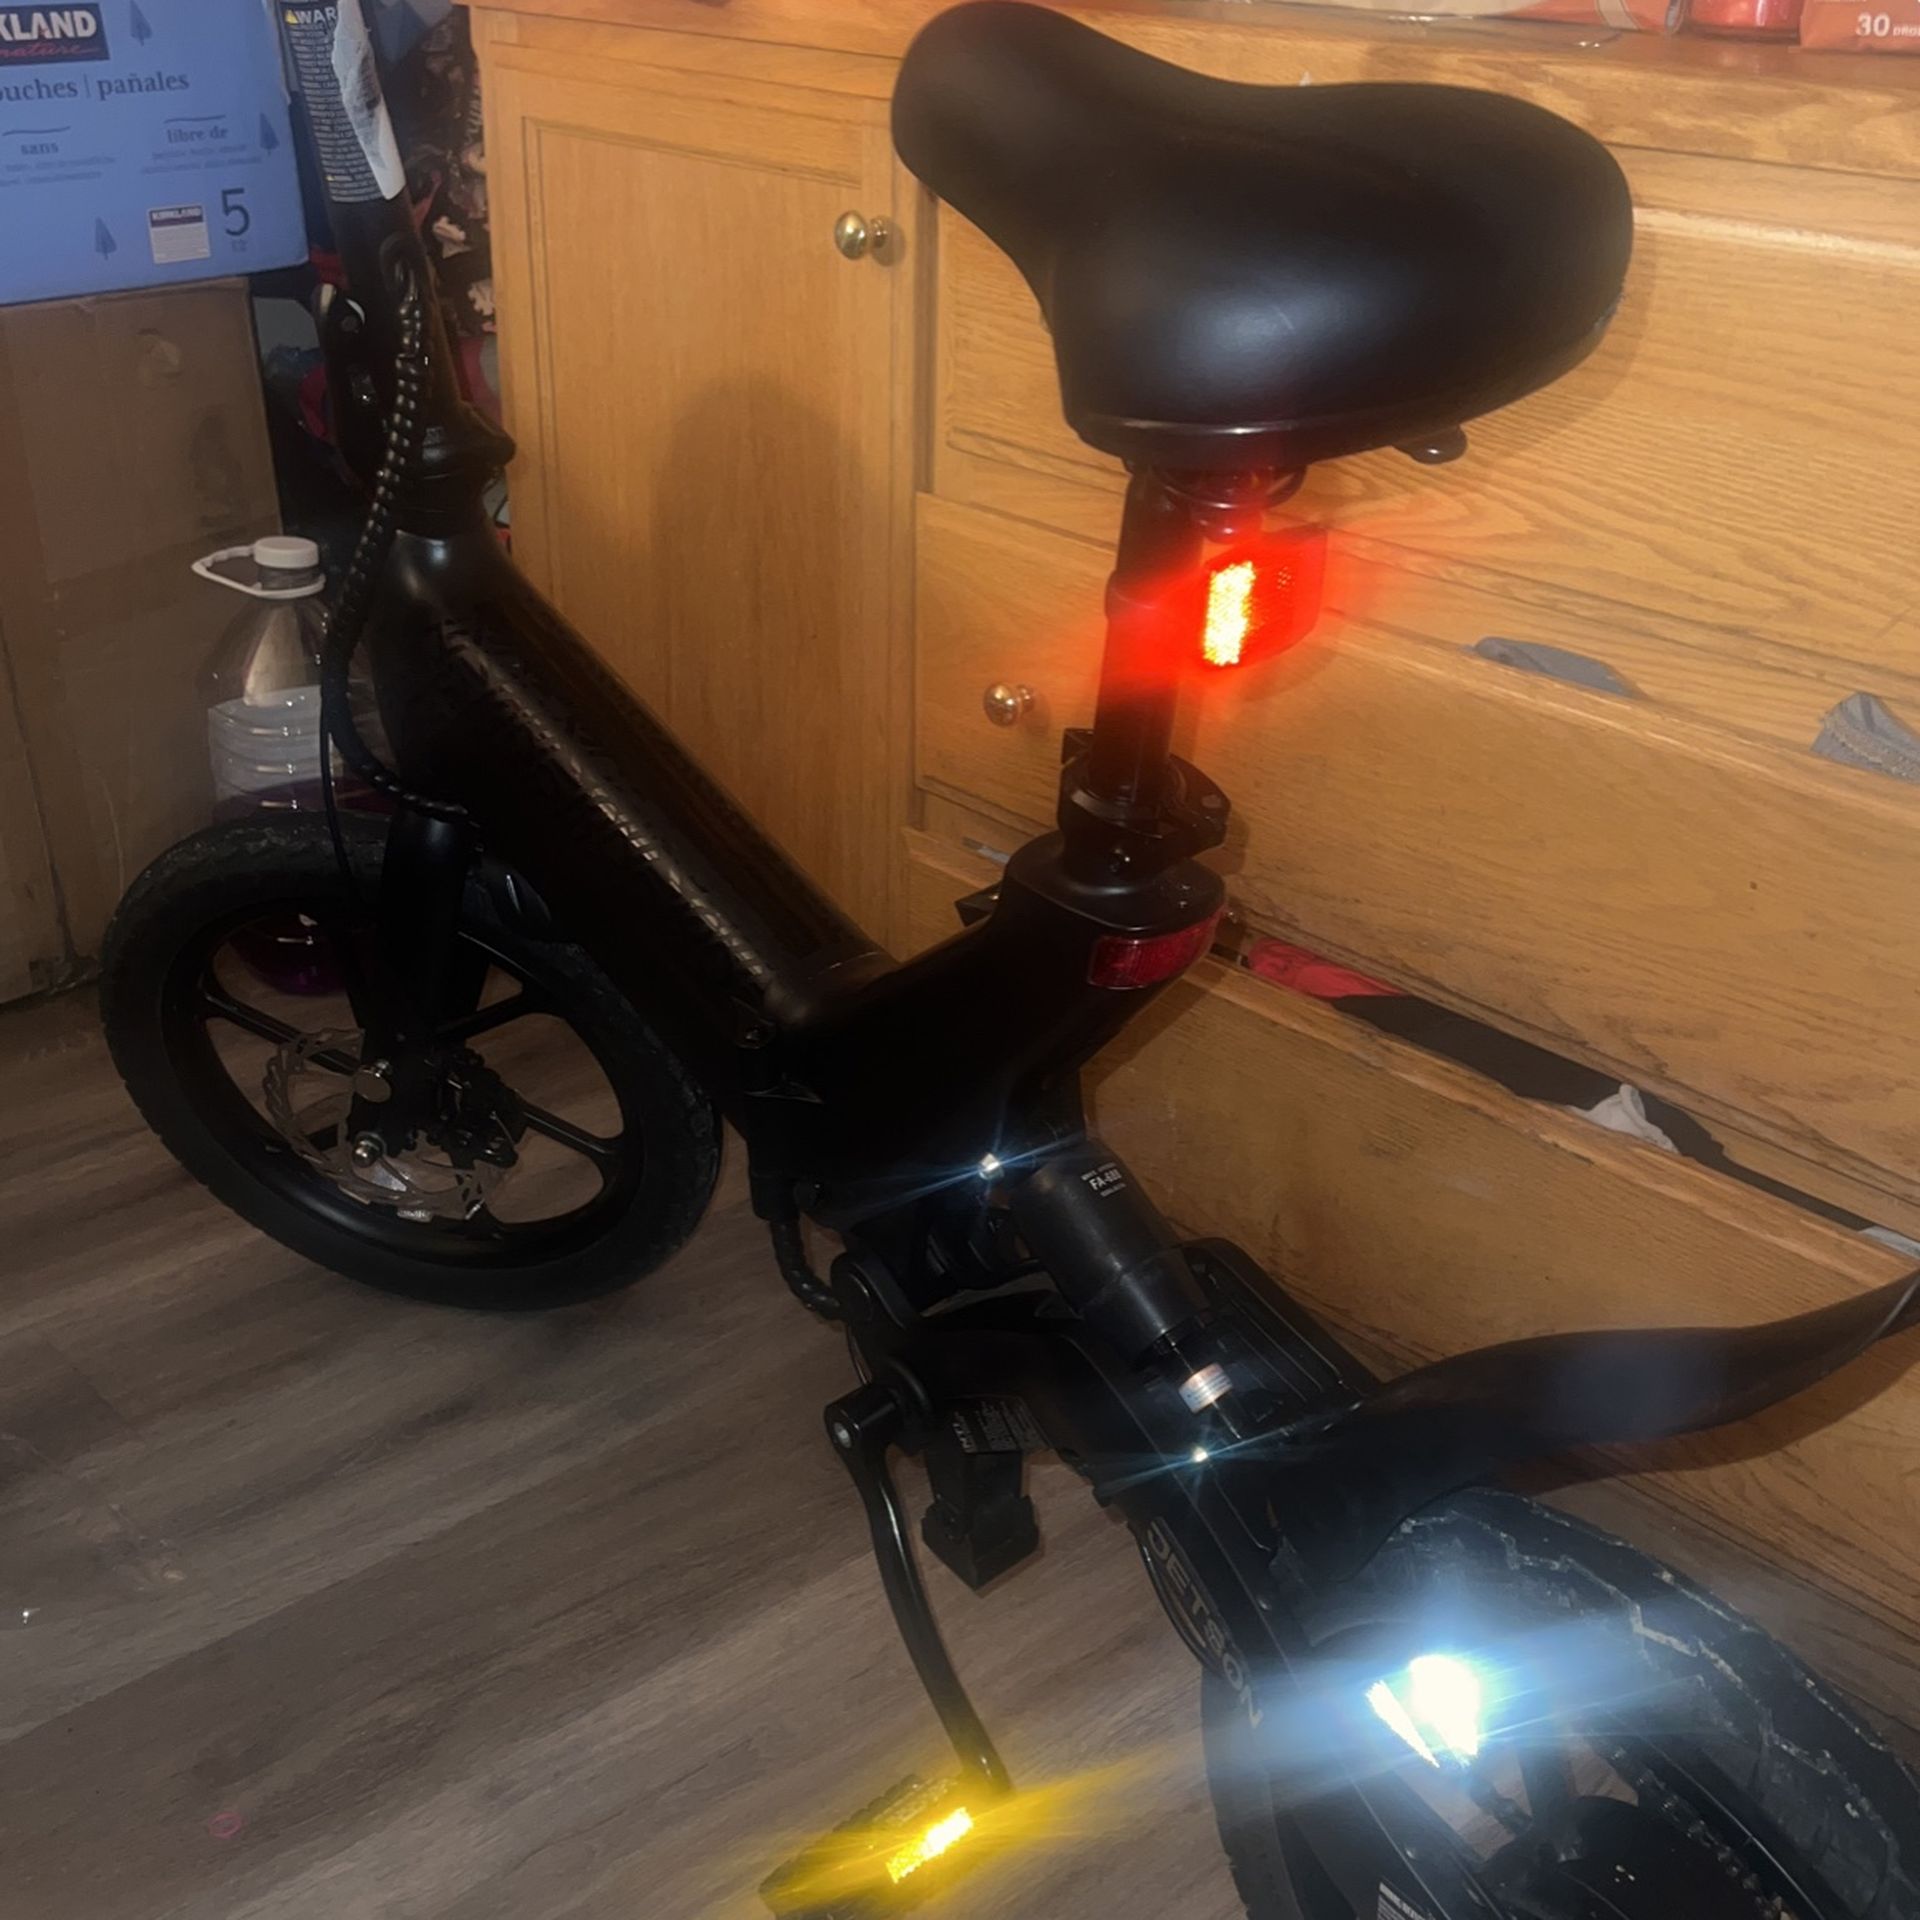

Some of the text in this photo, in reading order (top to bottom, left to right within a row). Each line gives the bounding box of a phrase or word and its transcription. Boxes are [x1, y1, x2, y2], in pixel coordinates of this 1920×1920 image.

[1855, 12, 1891, 37] 30
[97, 70, 190, 102] pañales
[20, 141, 59, 155] sans
[167, 127, 205, 144] libre
[221, 188, 250, 237] 5
[1148, 1519, 1264, 1729] JETSON
